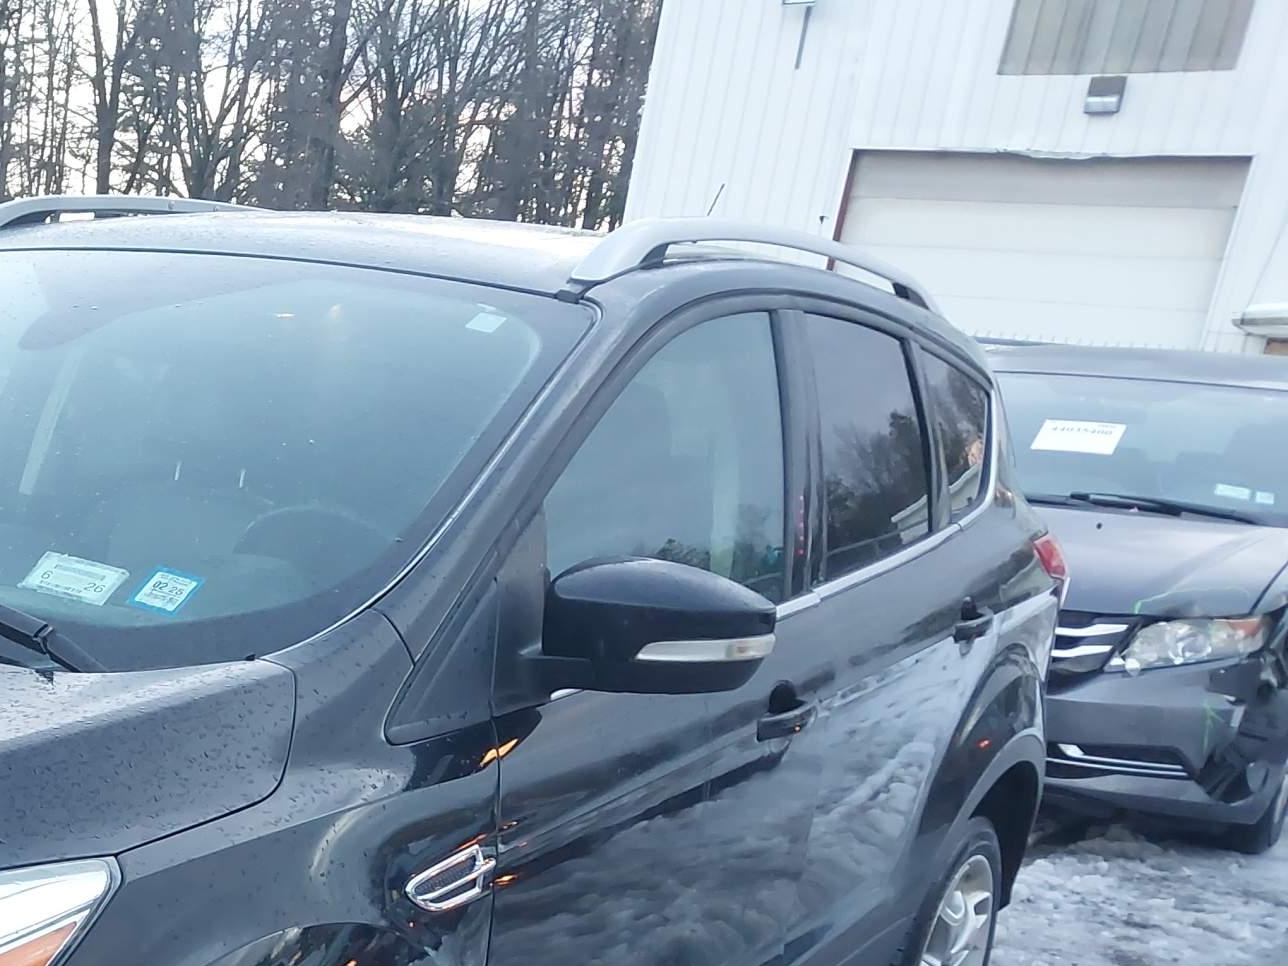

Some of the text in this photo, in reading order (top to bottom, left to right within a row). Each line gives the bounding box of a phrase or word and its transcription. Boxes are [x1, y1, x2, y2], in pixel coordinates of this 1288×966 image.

[41, 570, 53, 580] 6
[84, 582, 105, 593] 26
[152, 580, 169, 591] 02
